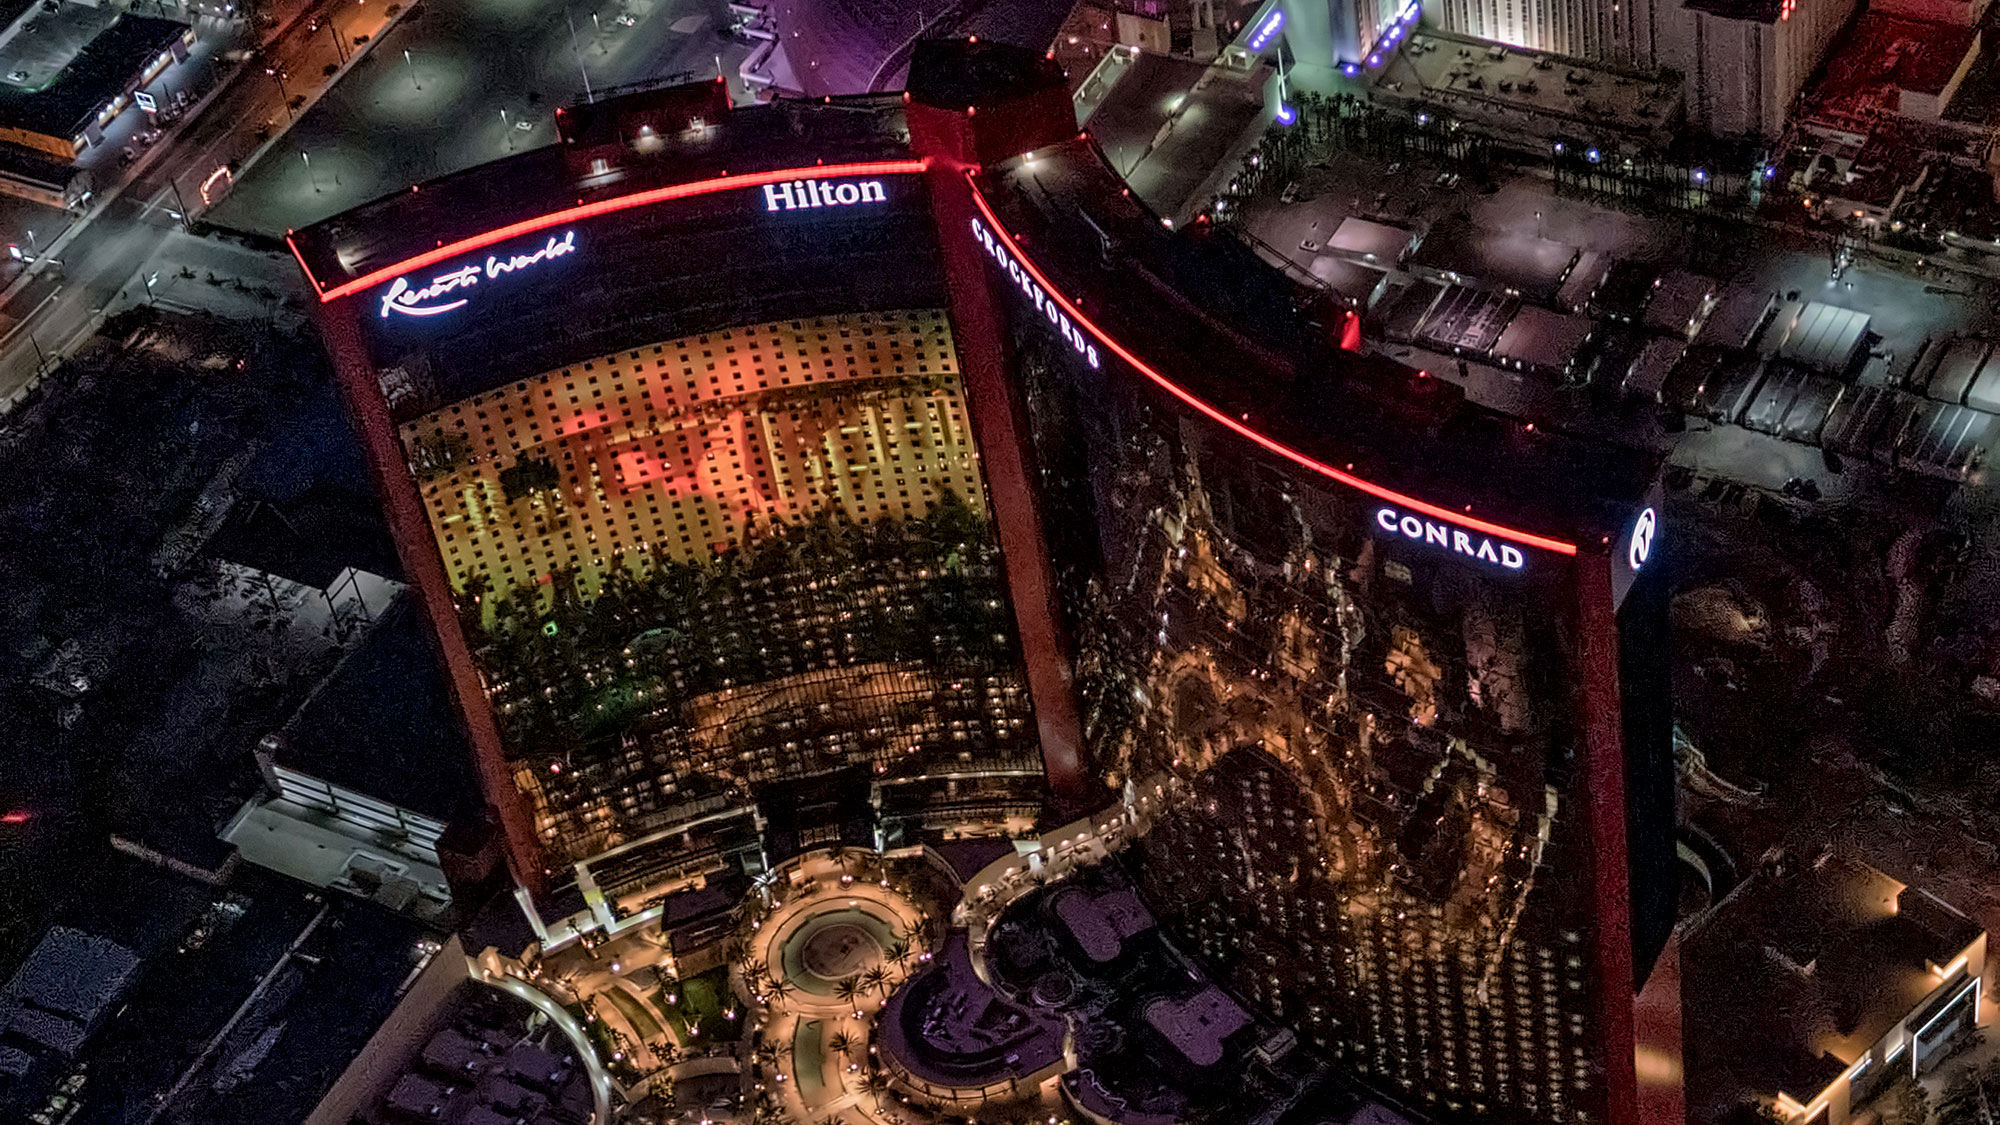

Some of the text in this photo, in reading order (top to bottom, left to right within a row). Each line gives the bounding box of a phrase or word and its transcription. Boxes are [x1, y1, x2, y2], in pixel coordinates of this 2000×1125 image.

[763, 180, 887, 211] Hilton
[381, 230, 575, 318] Resorts World
[971, 218, 1099, 368] CROCKFORDS
[1377, 508, 1524, 569] CONRAD
